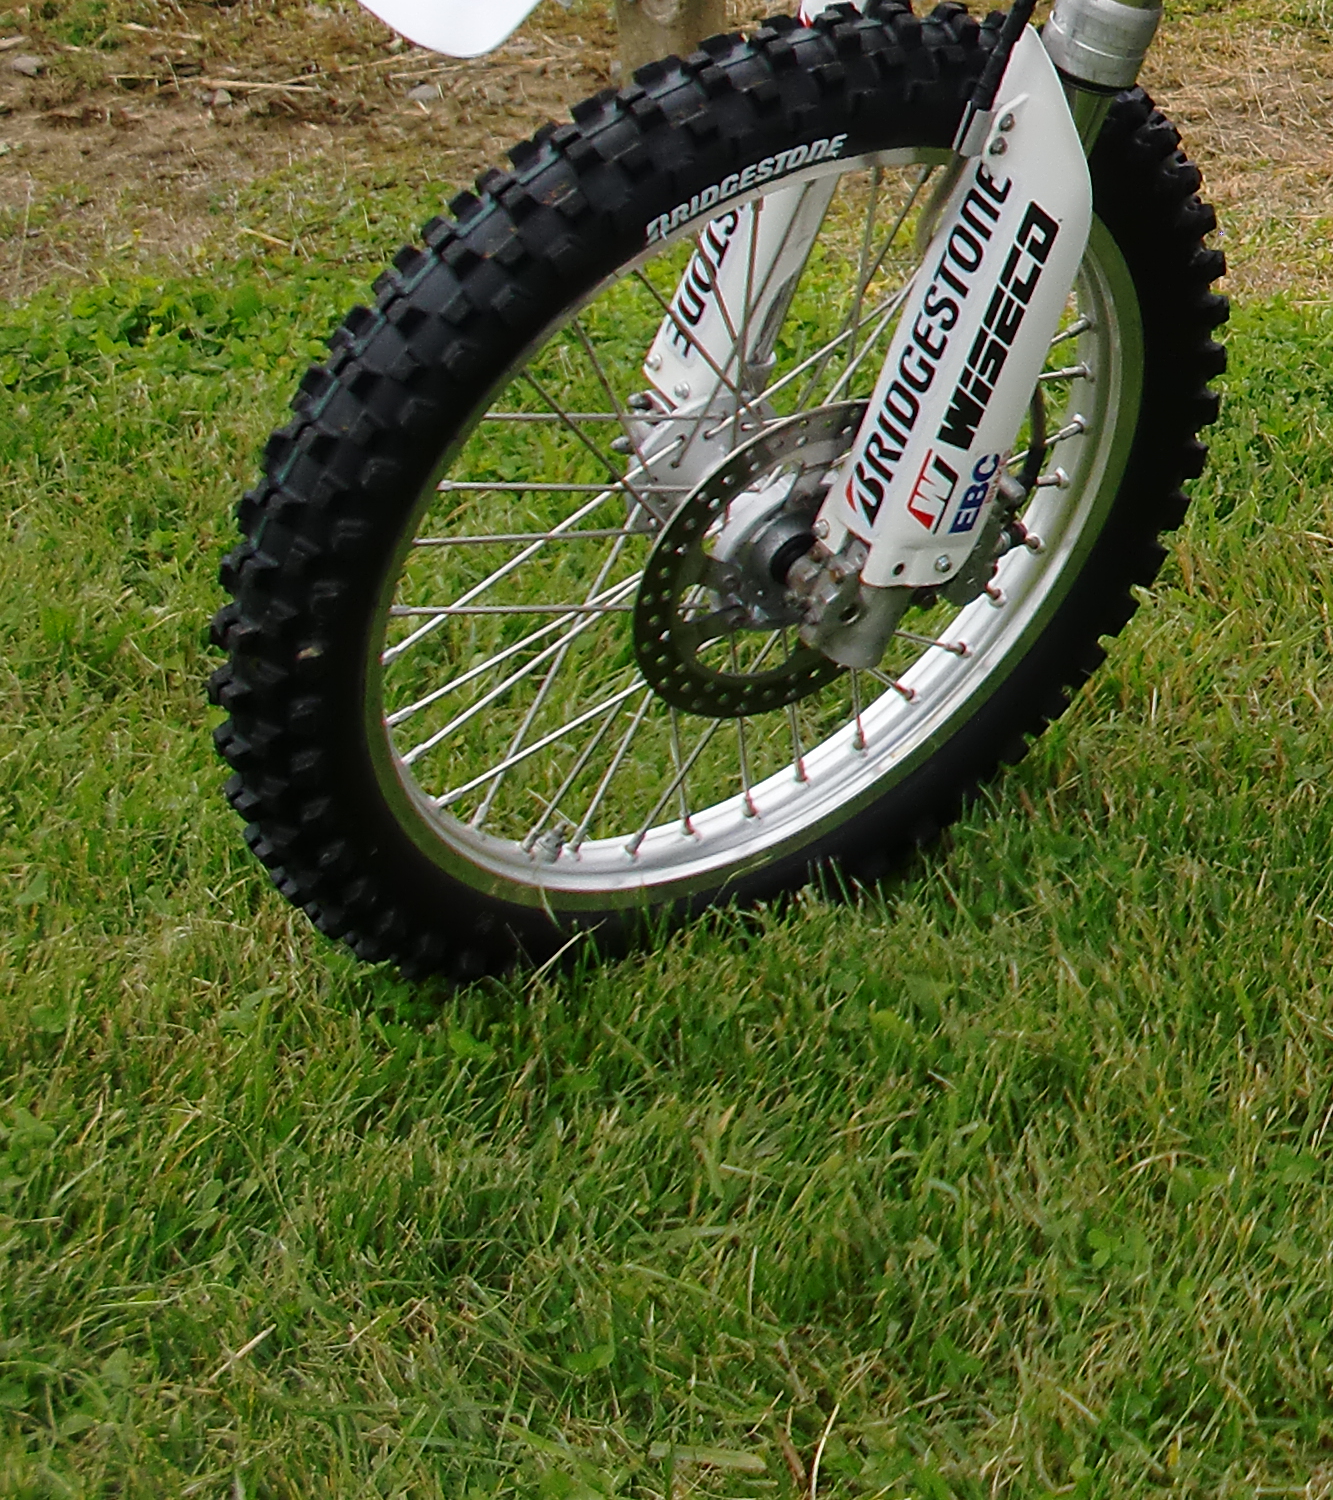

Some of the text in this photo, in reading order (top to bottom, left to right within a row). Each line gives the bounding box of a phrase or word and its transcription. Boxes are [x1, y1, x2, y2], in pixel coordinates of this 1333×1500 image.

[646, 133, 848, 244] BRIDGESTONE
[846, 160, 1012, 529] BRIDGESTONE
[948, 453, 1000, 534] EBC
